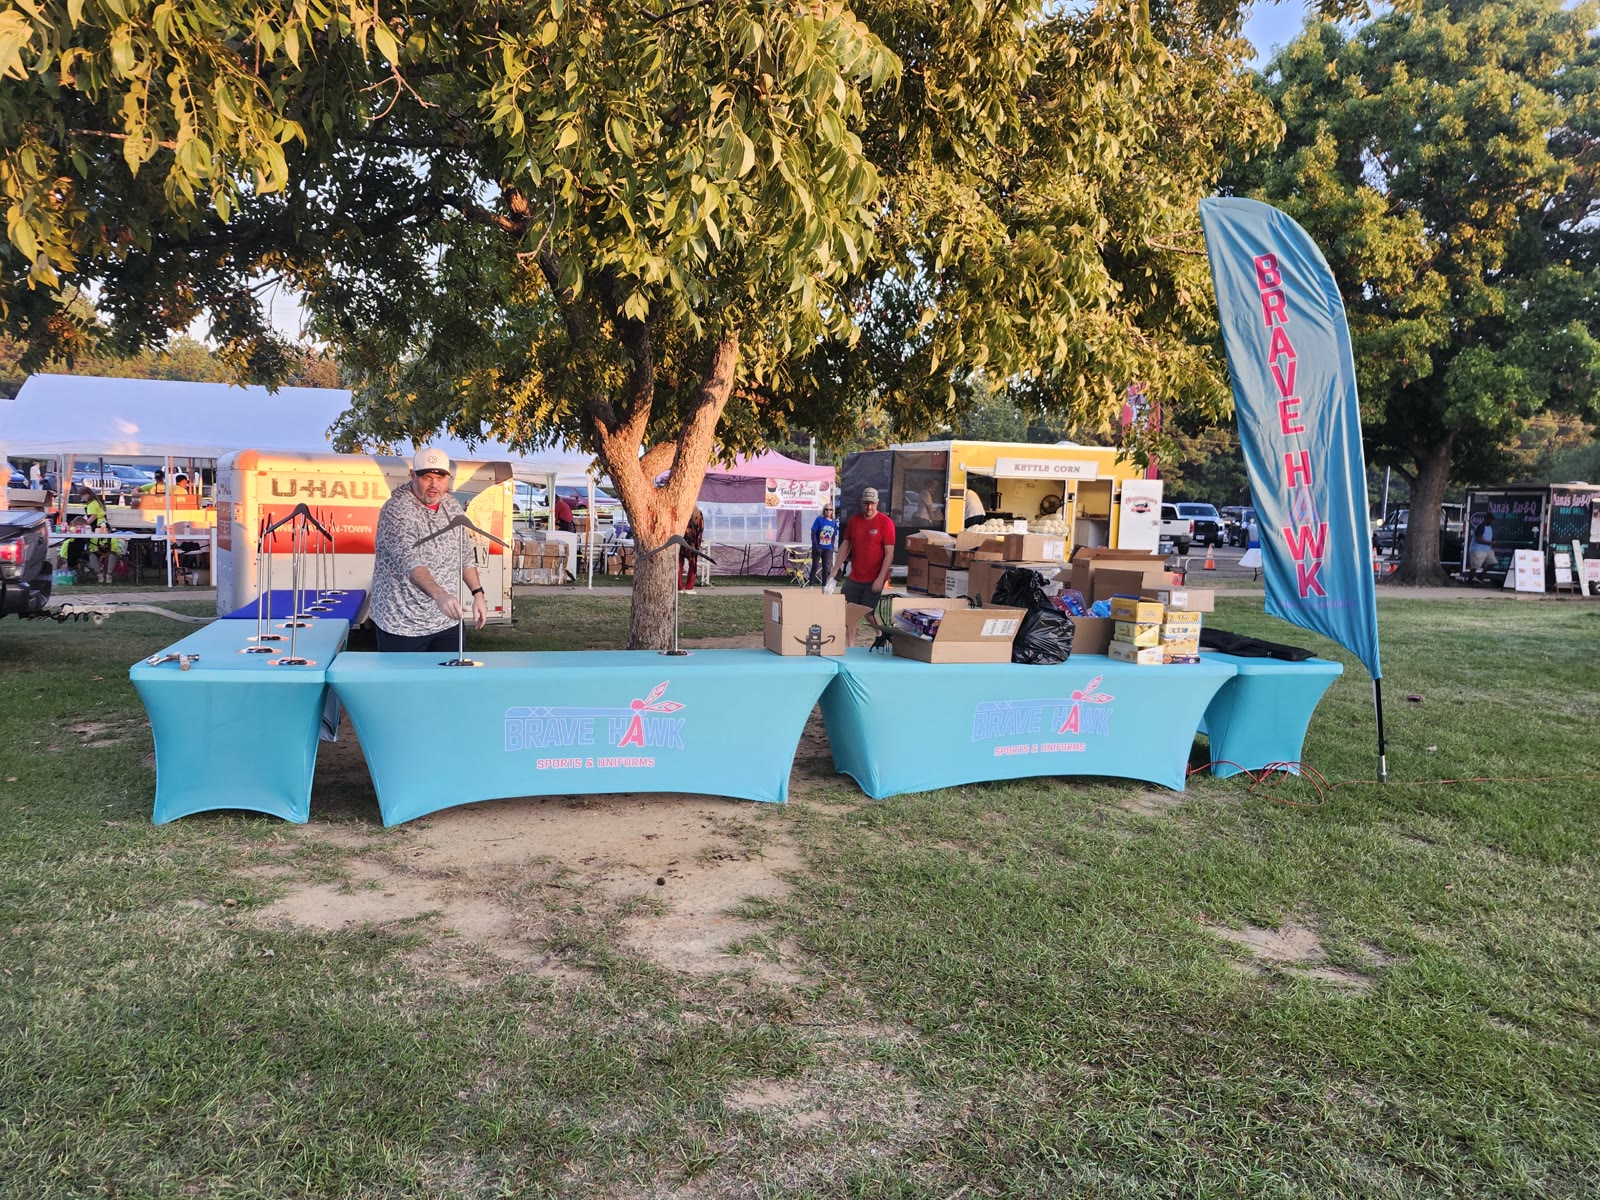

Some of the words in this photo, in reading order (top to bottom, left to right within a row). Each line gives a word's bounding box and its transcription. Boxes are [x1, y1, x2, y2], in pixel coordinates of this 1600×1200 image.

[1253, 252, 1305, 436] BRAVE
[1281, 450, 1330, 599] HAWK
[1014, 463, 1049, 472] KETTLE
[1053, 465, 1080, 473] CORN
[272, 478, 387, 500] U-HAUL
[779, 488, 797, 498] Tasty
[1553, 493, 1571, 506] Nana's
[1488, 501, 1510, 513] Nana's
[1512, 501, 1537, 515] Bar-B-Q
[972, 708, 1043, 742] BRAVE
[1051, 704, 1114, 737] HAWK
[504, 717, 595, 752] BRAVE
[608, 714, 686, 749] HAWK
[994, 744, 1029, 756] SPORTS
[1031, 744, 1038, 753] &
[1041, 742, 1086, 752] UNIFORMS
[536, 758, 582, 769] SPORTS
[585, 758, 593, 767] &
[597, 757, 655, 768] UNIFORMS
